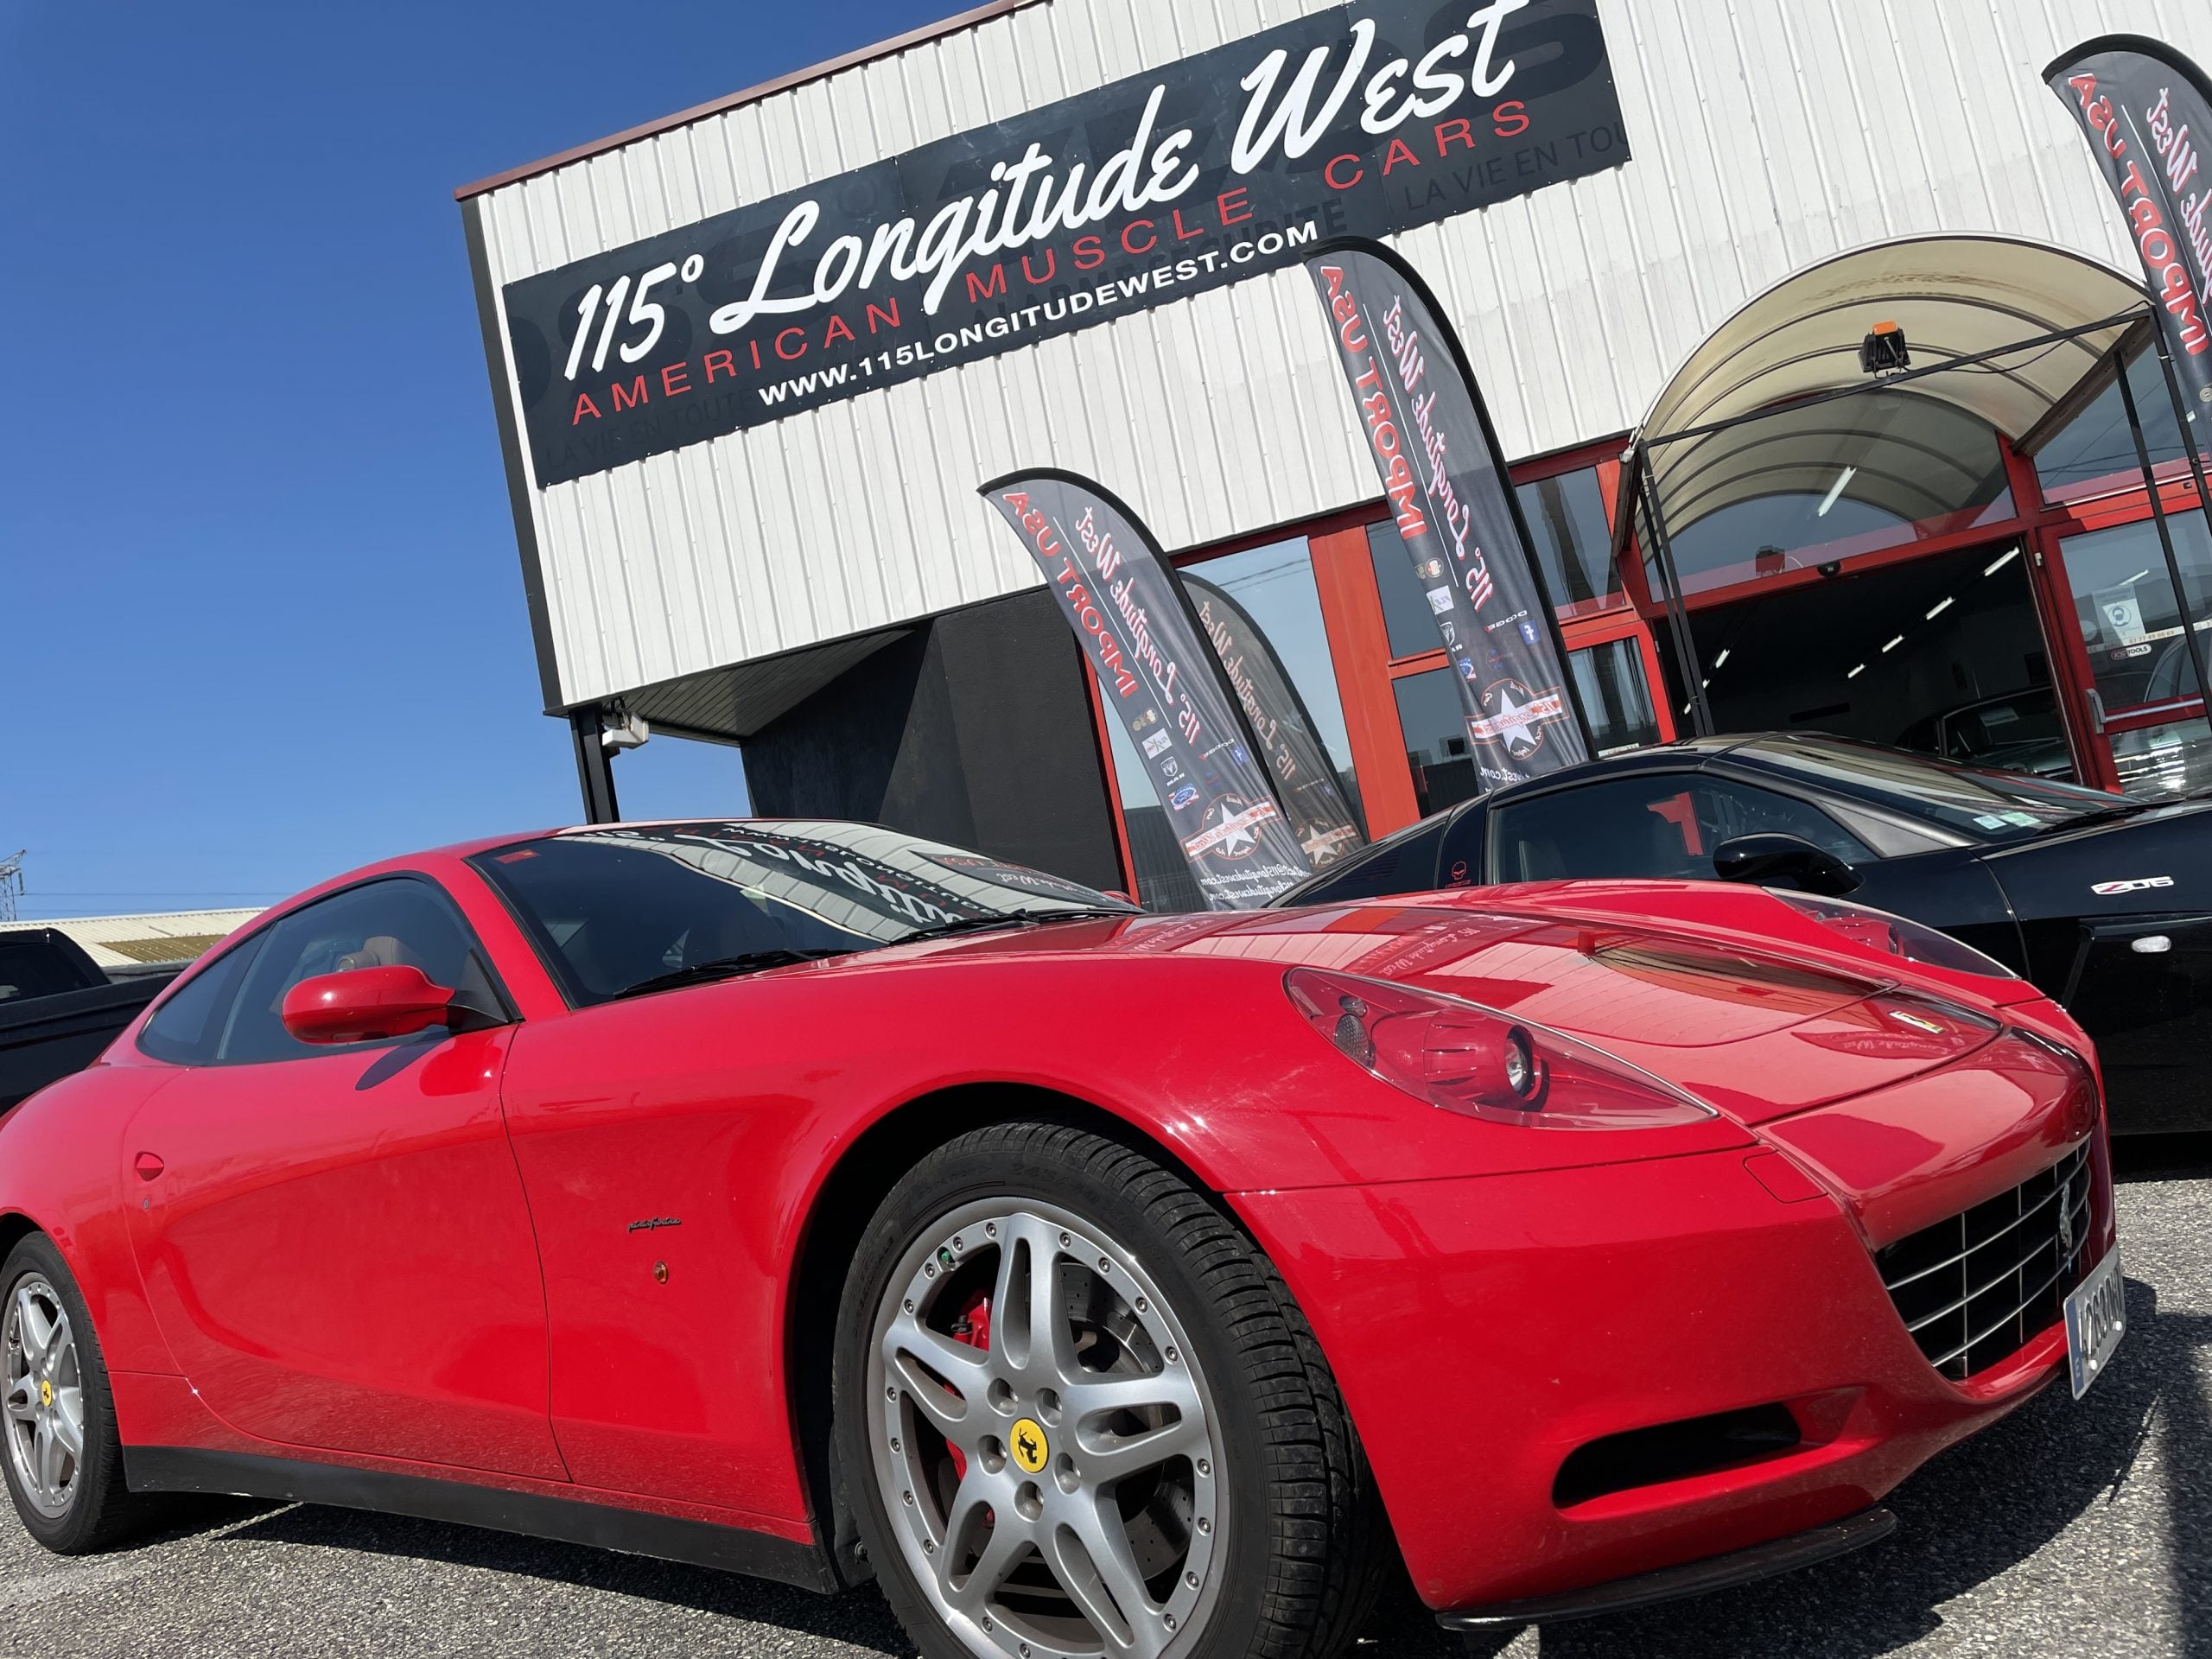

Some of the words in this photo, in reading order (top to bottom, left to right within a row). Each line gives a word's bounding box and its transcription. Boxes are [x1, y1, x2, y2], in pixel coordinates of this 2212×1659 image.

[709, 84, 1199, 315] Longitude
[1230, 0, 1531, 175] West
[1404, 178, 1446, 212] LA
[1452, 156, 1507, 194] VIE
[1514, 141, 1560, 177] EN
[572, 296, 901, 425] AMERICAN
[965, 186, 1253, 303] MUSCLE
[1324, 99, 1530, 190] CARS
[759, 219, 1319, 407] WWW.115LONGITUDEWEST.COM
[2127, 645, 2148, 655] TOOLS
[2090, 876, 2174, 895] Z06
